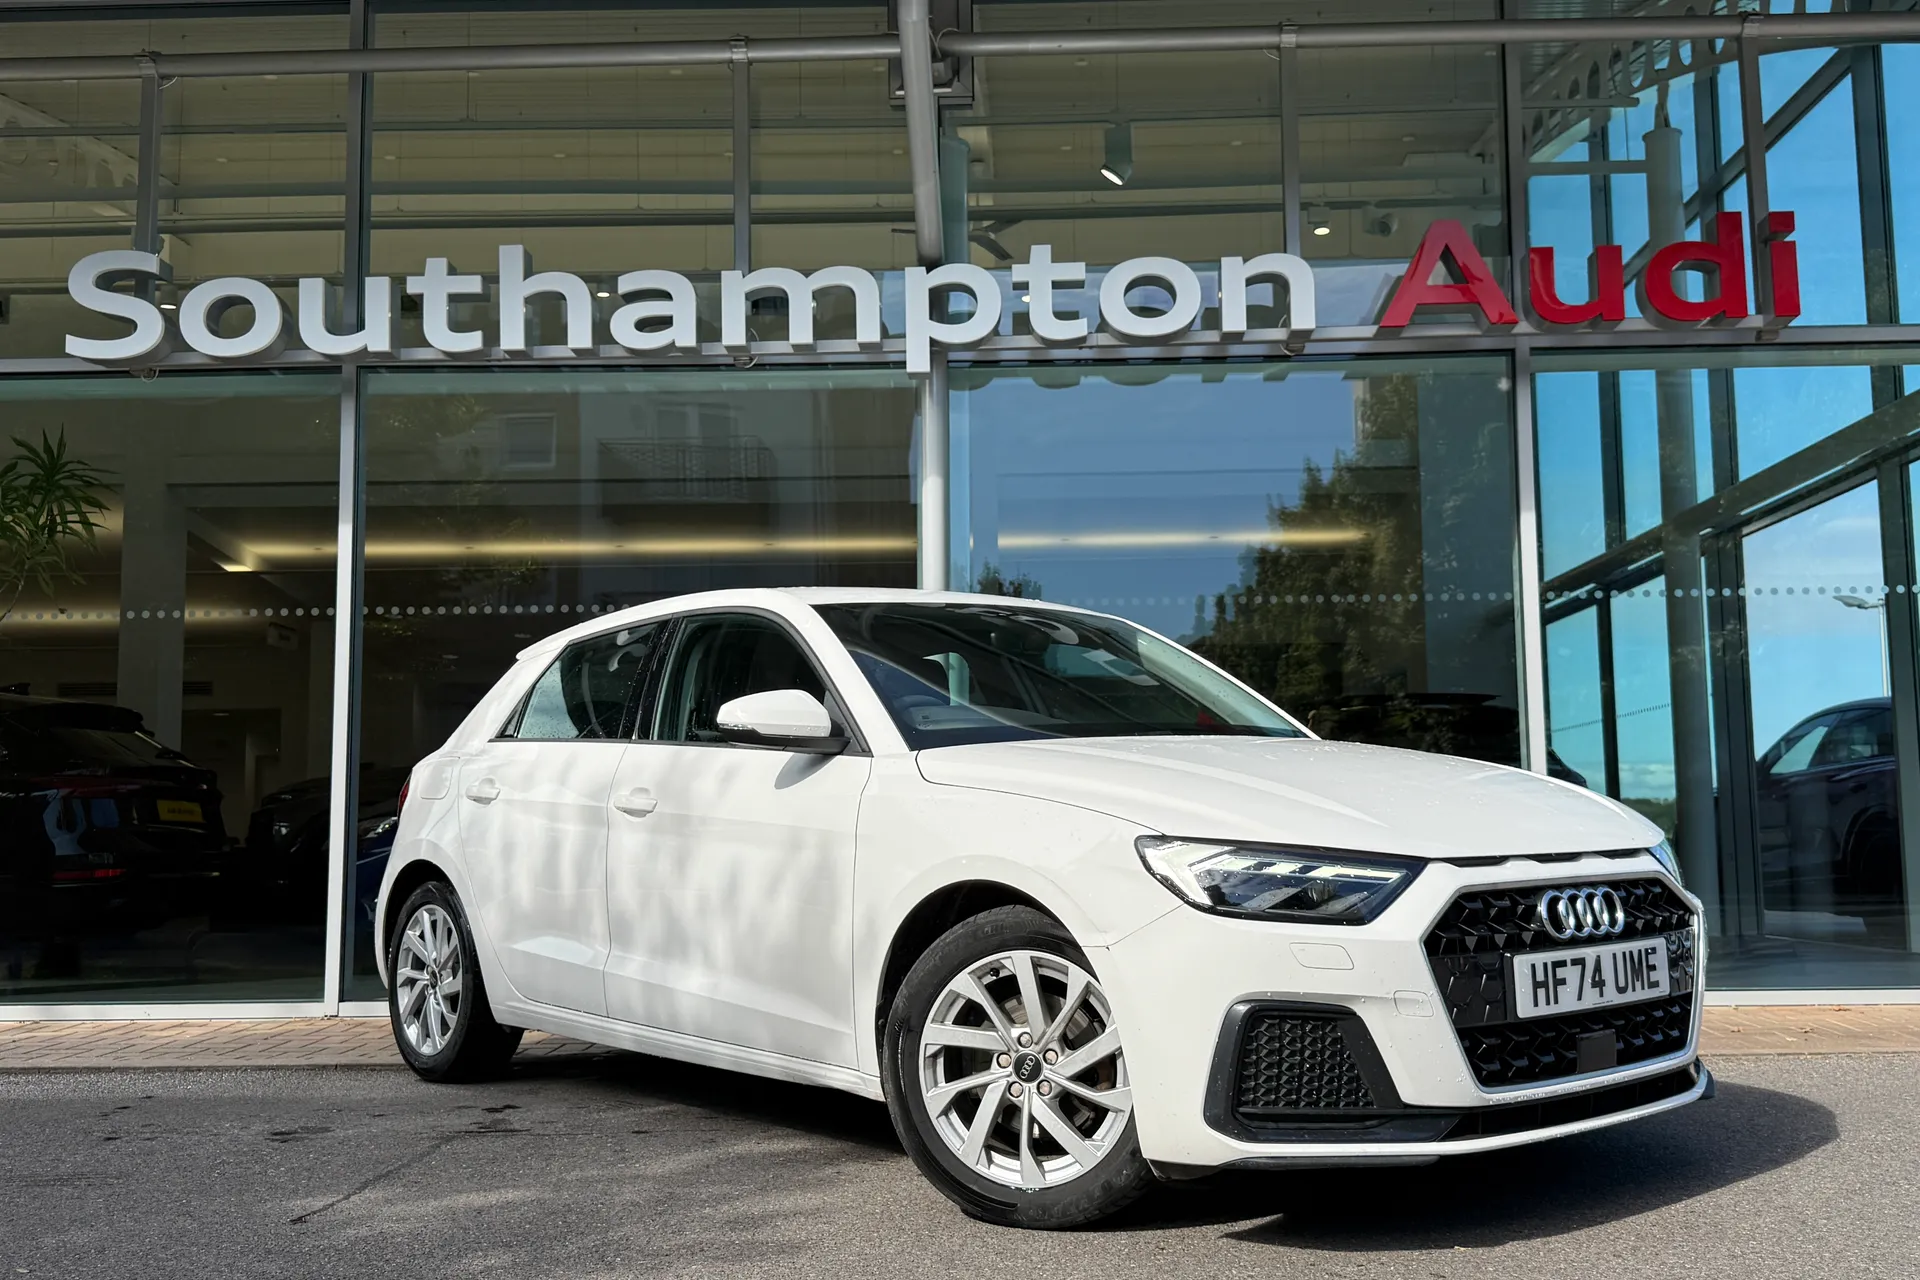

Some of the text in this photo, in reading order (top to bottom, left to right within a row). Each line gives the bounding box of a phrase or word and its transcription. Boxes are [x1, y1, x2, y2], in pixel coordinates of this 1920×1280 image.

[65, 211, 1800, 374] Southampton Audi
[1530, 946, 1659, 1007] HF74 UME
